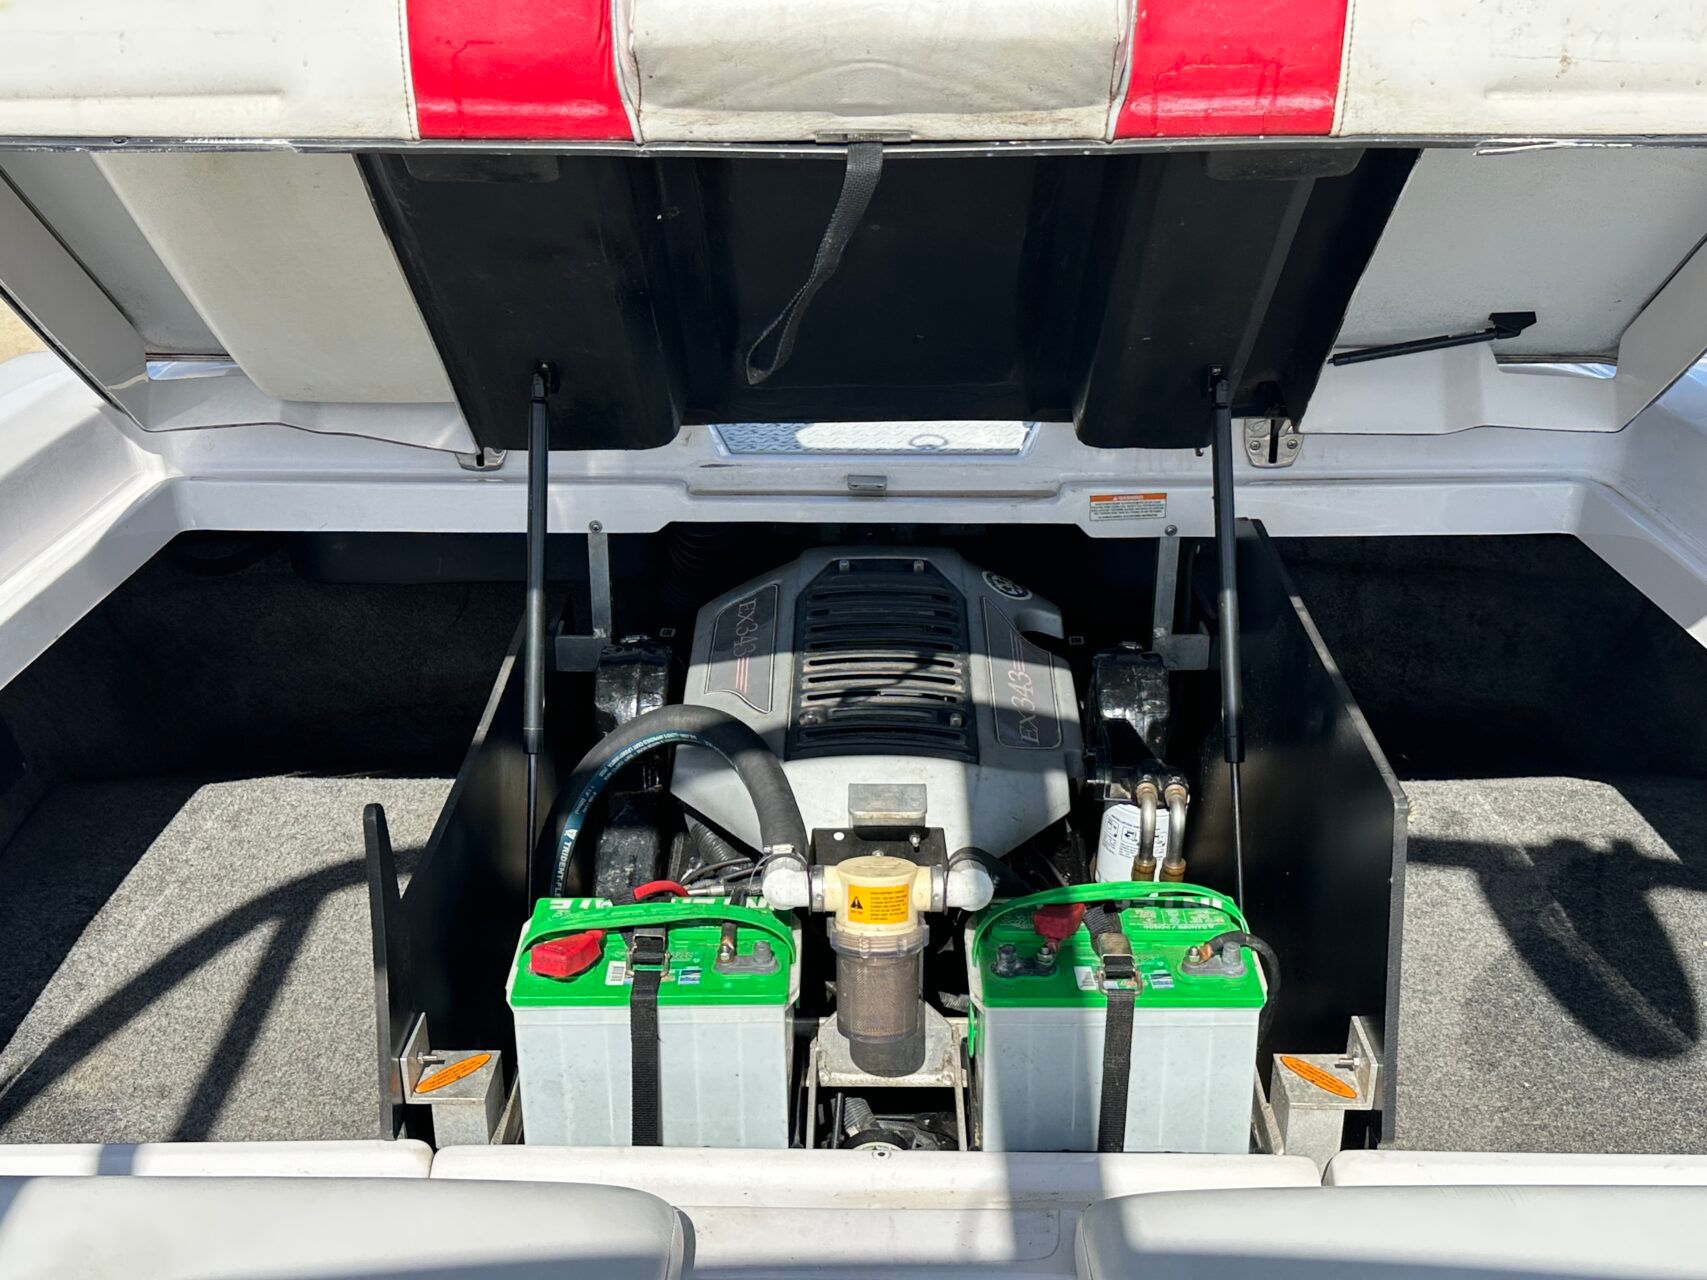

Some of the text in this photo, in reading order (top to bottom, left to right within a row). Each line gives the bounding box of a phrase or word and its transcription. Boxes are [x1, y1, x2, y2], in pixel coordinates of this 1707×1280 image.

[733, 599, 758, 657] EX343
[1007, 669, 1040, 745] EX343
[554, 840, 574, 898] TRIDENT-FLE
